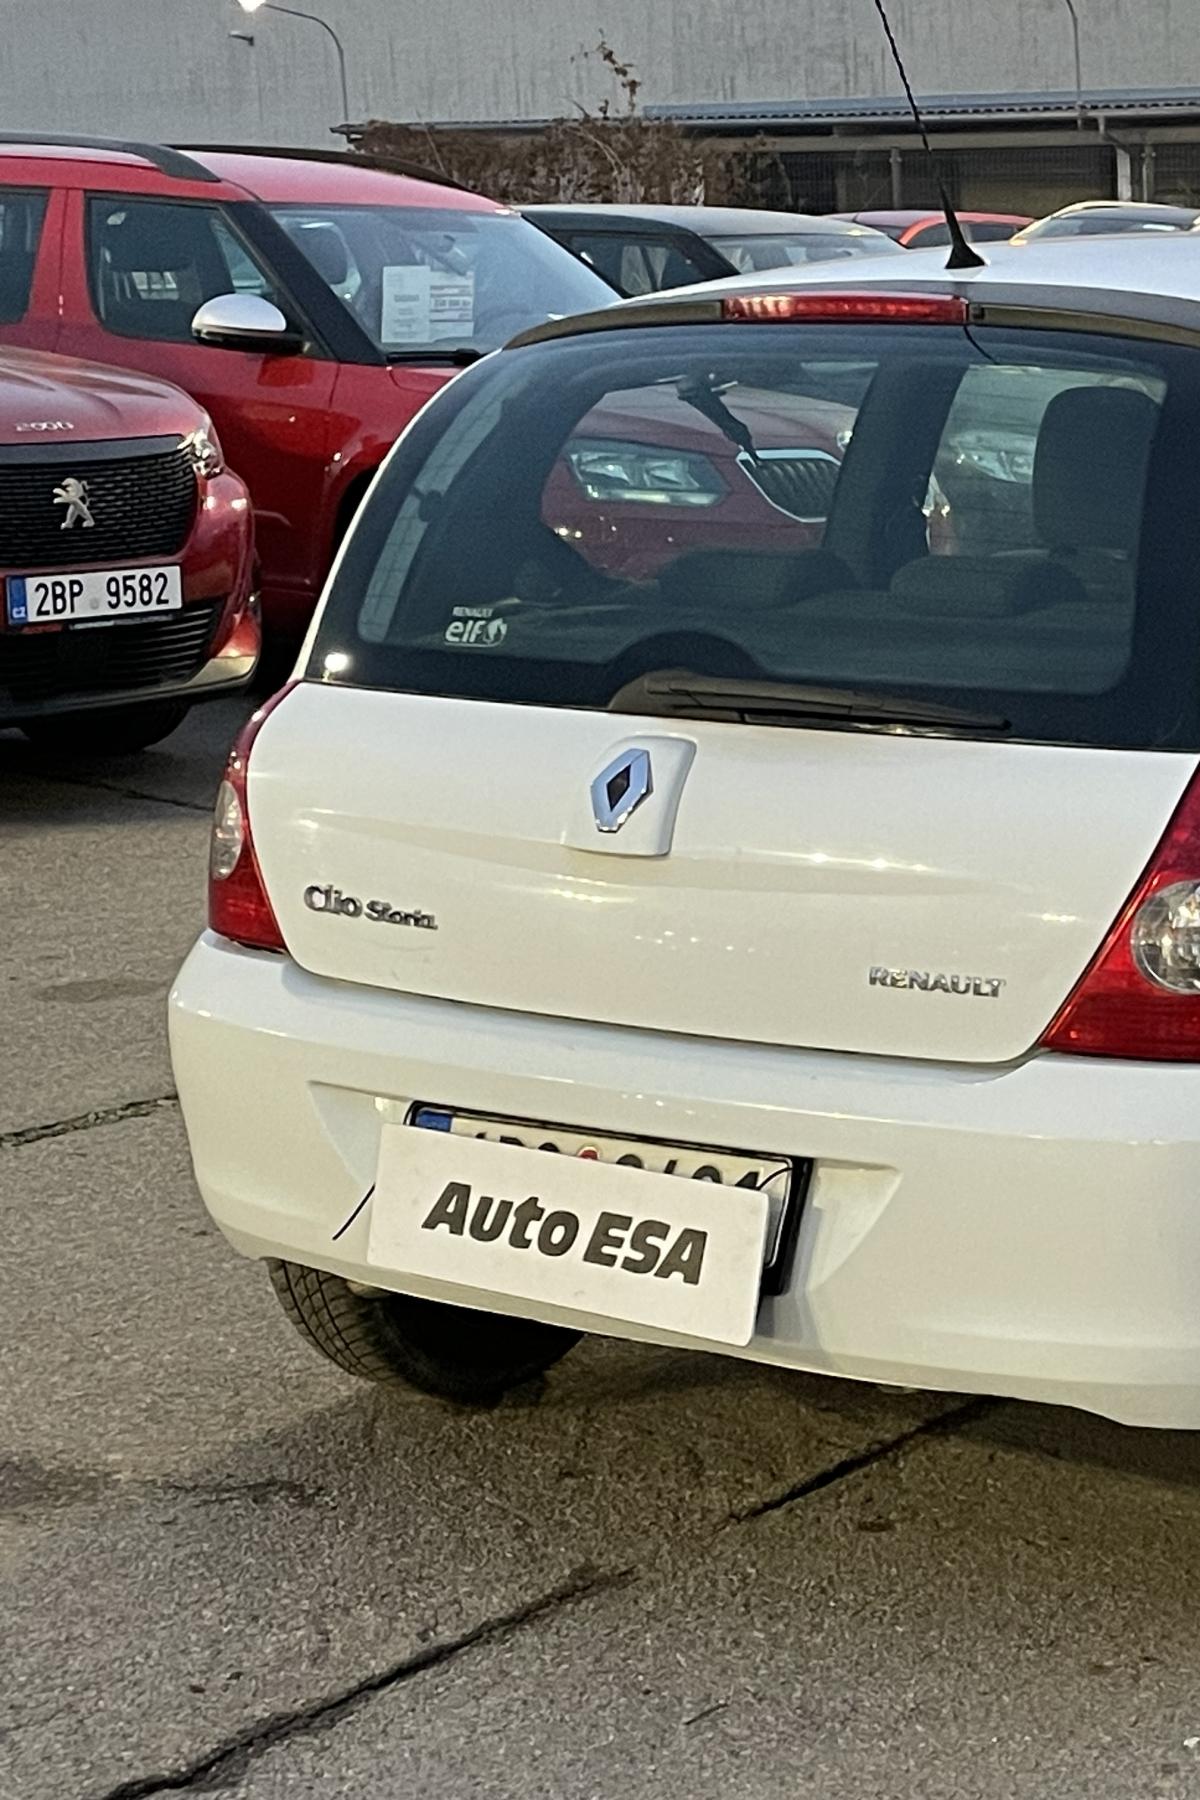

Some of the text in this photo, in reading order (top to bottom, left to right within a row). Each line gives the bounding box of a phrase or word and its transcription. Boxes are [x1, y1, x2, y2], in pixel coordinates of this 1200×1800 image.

[34, 572, 169, 617] 2BP 9582
[445, 620, 486, 642] elf
[303, 884, 438, 930] Clio Storia
[868, 966, 1007, 998] RENAULT
[421, 1181, 708, 1286] Auto ESA
